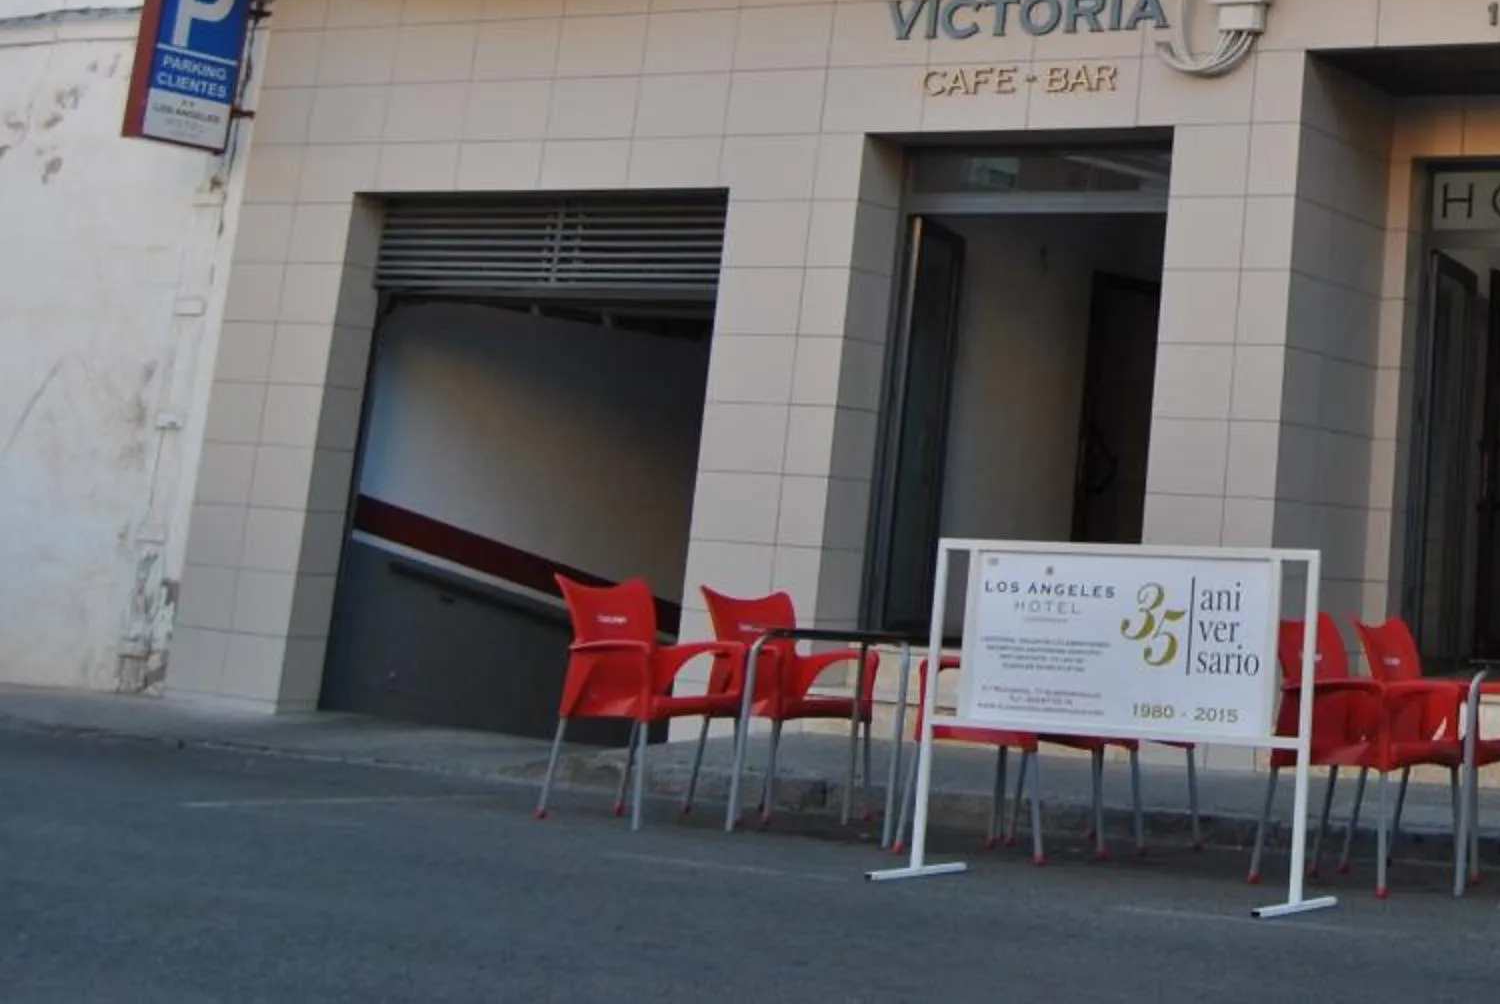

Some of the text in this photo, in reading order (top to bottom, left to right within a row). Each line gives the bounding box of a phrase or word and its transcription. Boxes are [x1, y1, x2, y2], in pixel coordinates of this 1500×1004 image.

[162, 53, 228, 81] PARKING
[156, 72, 227, 98] CLIENTES
[922, 67, 1018, 97] CAFE
[1045, 64, 1118, 92] BAR
[985, 580, 1116, 599] LOS ANGELES
[1200, 582, 1241, 611] ani
[1014, 600, 1081, 616] HOTEL
[1199, 618, 1240, 643] ver
[1195, 645, 1260, 676] sario
[1132, 702, 1175, 720] 1980
[1193, 706, 1239, 724] 2015
